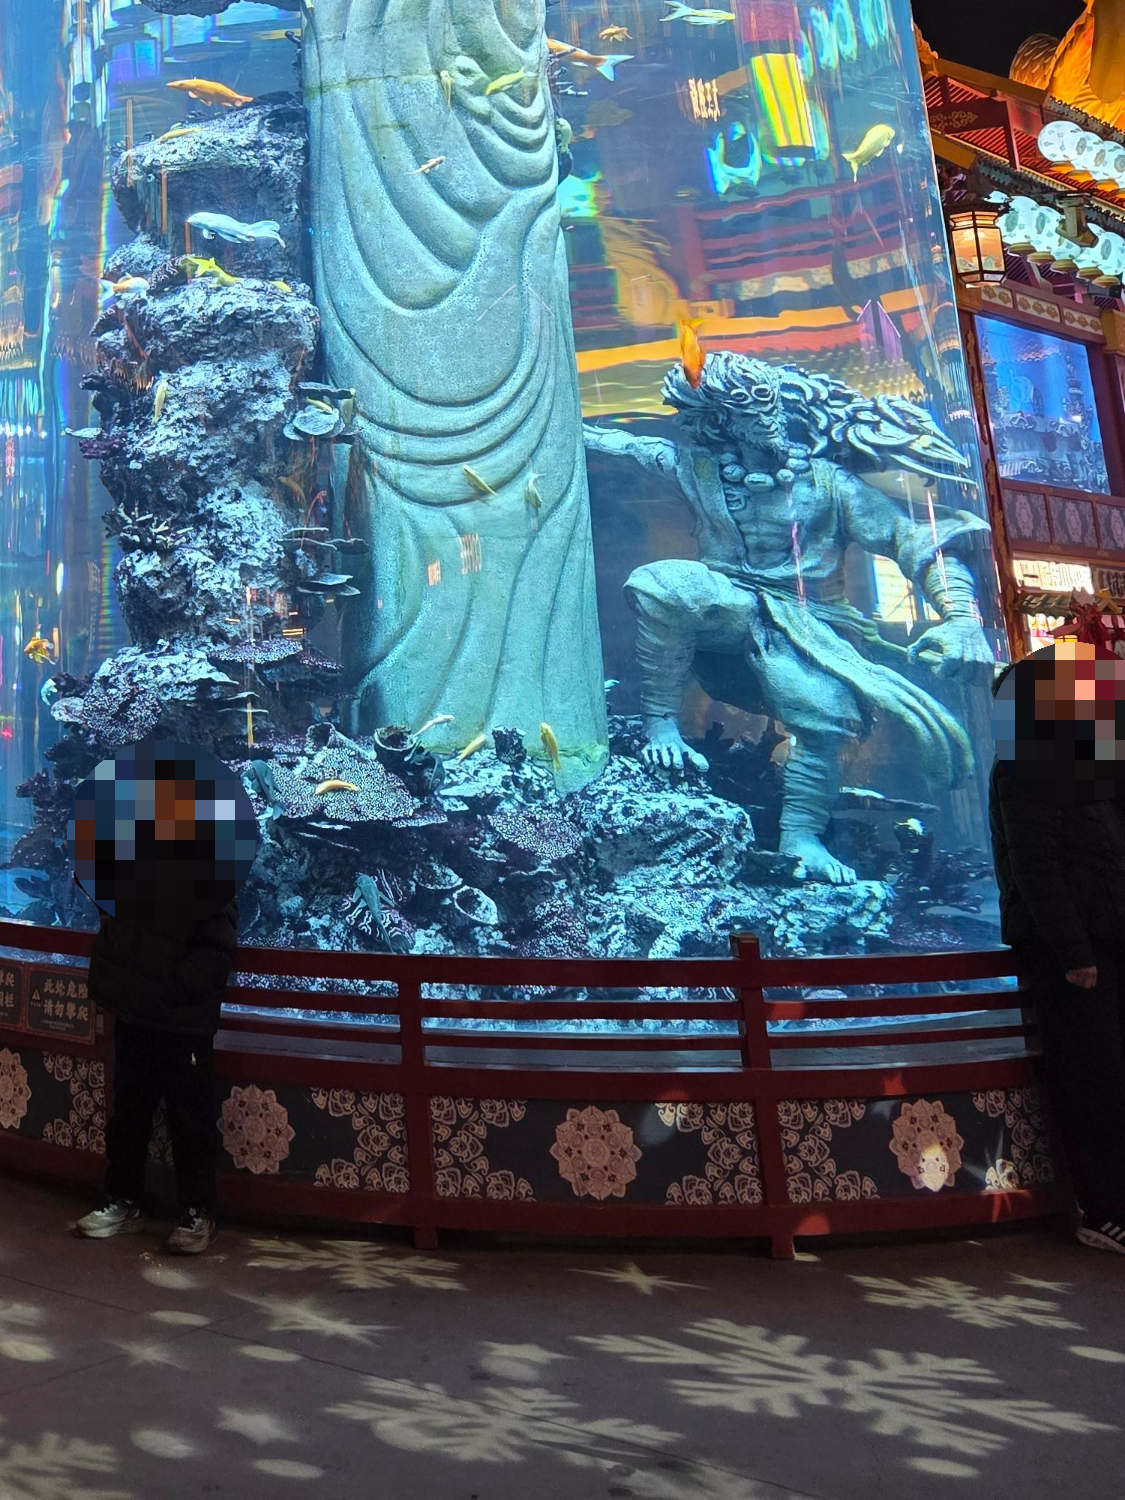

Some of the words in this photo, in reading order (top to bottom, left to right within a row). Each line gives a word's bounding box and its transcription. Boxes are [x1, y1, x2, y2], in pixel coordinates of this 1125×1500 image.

[43, 978, 89, 1000] 此处危险
[43, 999, 90, 1022] 请勿攀爬
